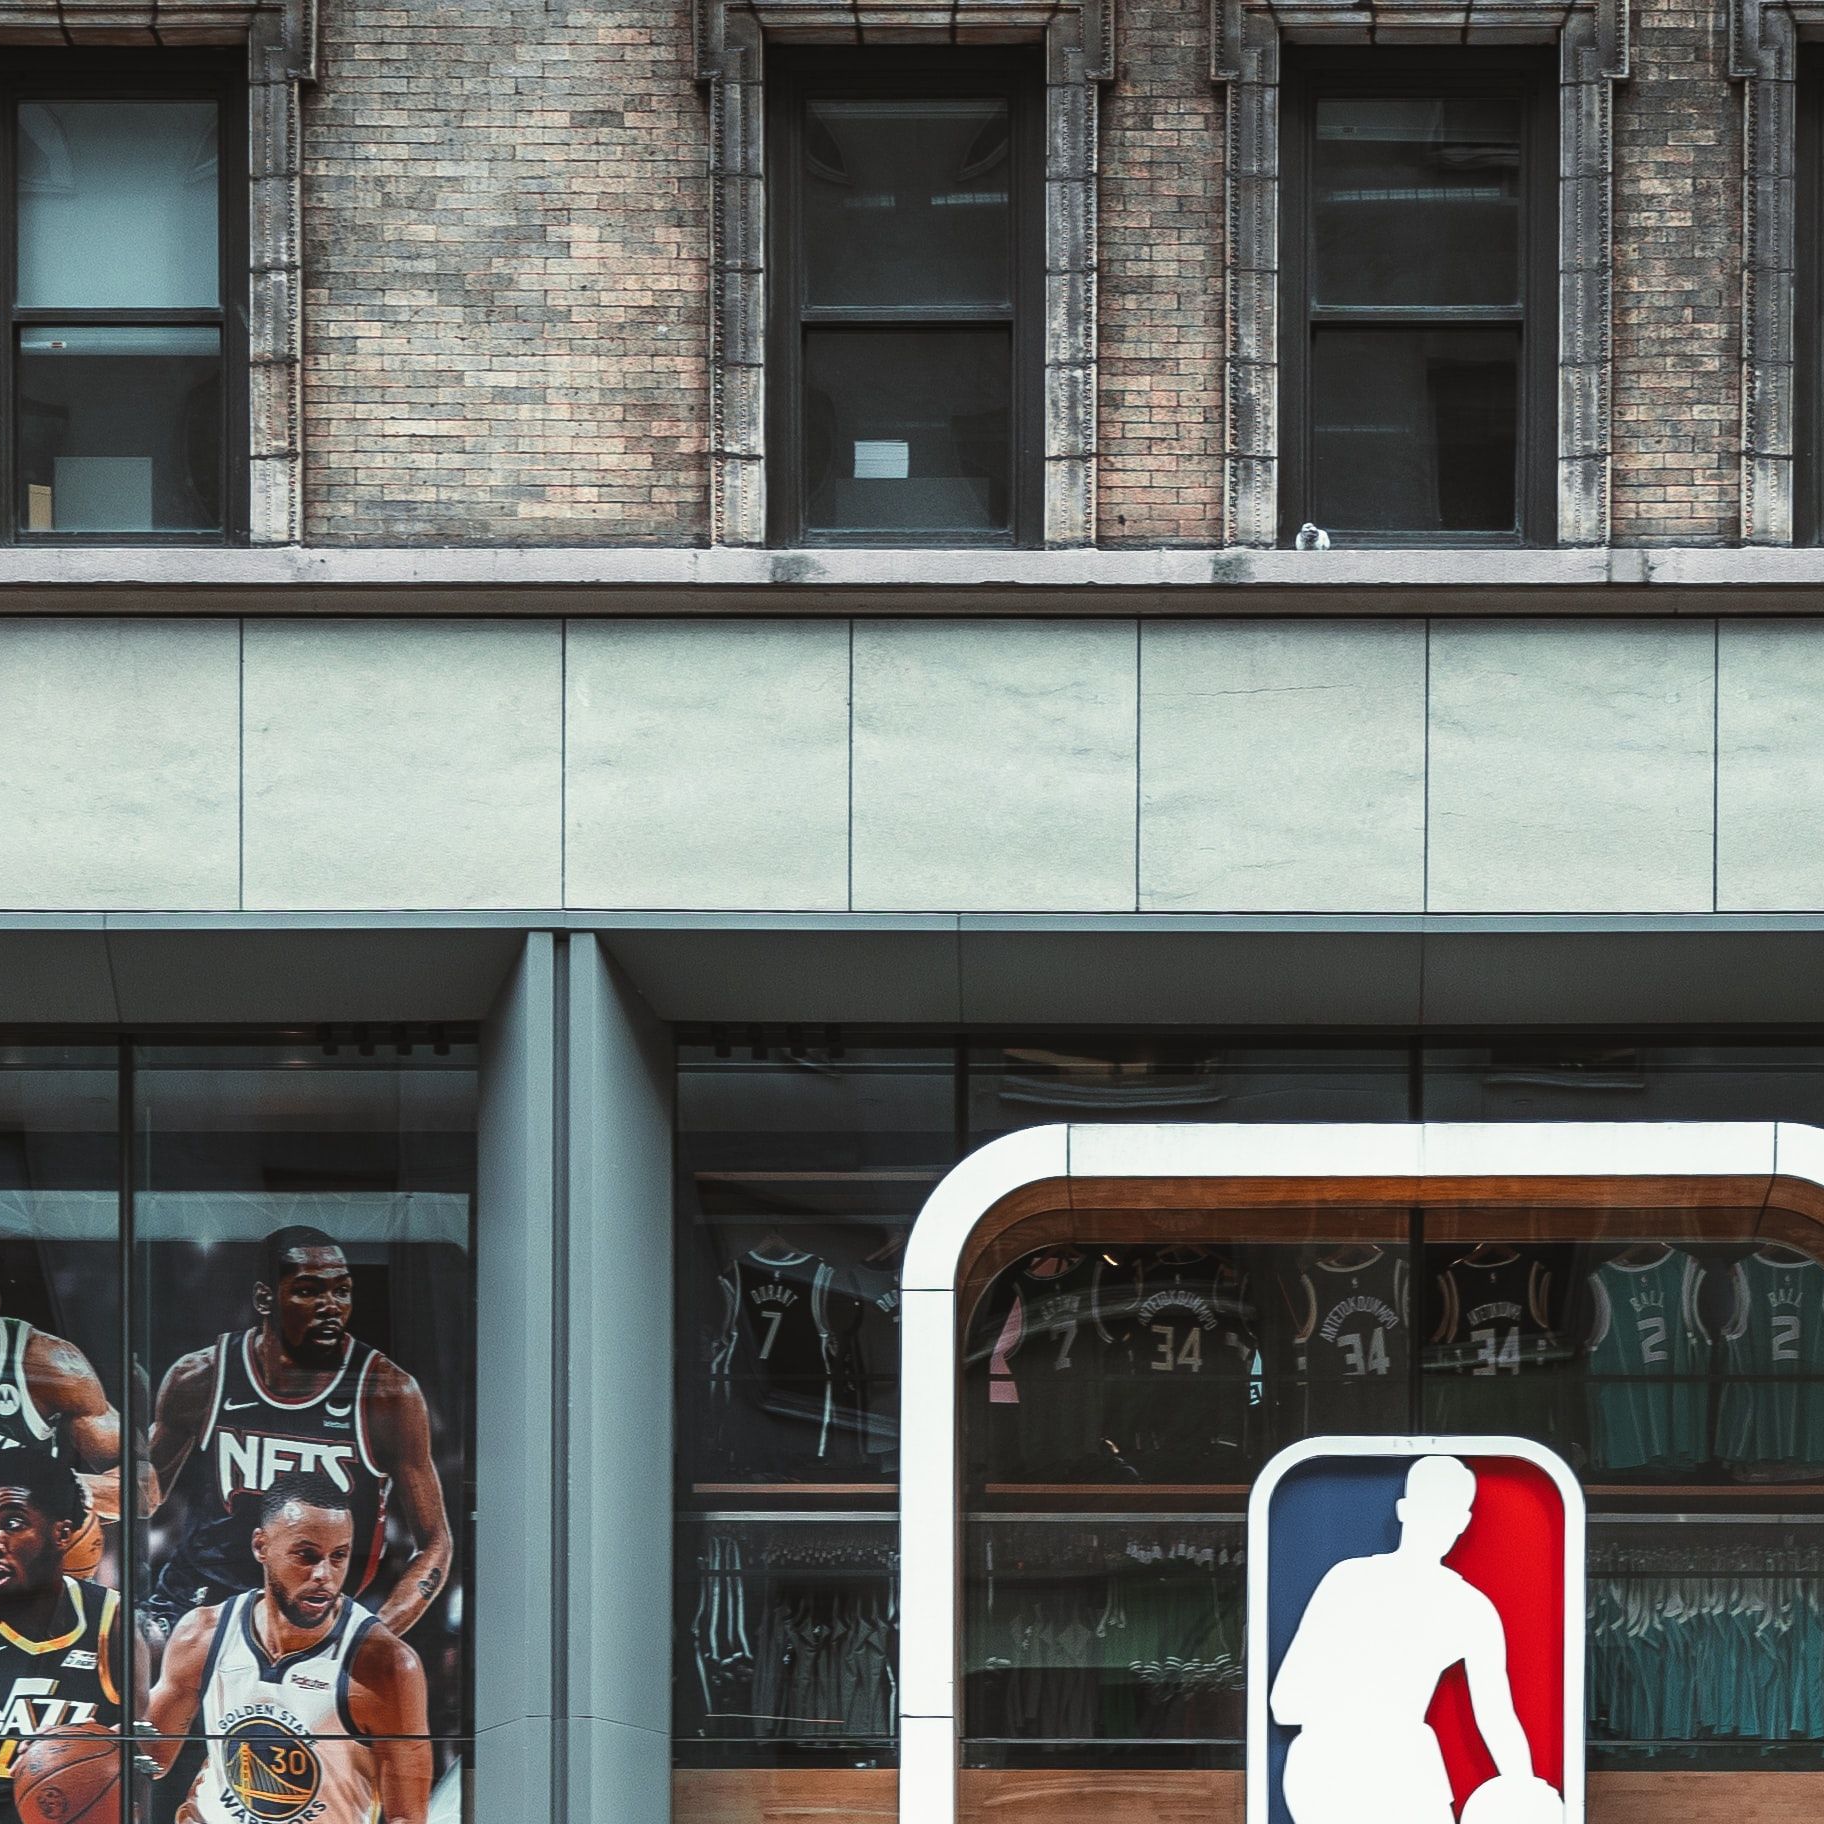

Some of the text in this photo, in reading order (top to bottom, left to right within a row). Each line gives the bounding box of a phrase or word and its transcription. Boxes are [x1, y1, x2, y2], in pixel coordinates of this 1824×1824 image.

[759, 1311, 783, 1359] 7
[1151, 1324, 1203, 1373] 34
[1336, 1327, 1390, 1376] 34
[1470, 1326, 1520, 1376] 34
[1637, 1317, 1669, 1364] 2
[1771, 1315, 1801, 1361] 2
[218, 1704, 275, 1731] GOLDEN
[269, 1746, 309, 1776] 30
